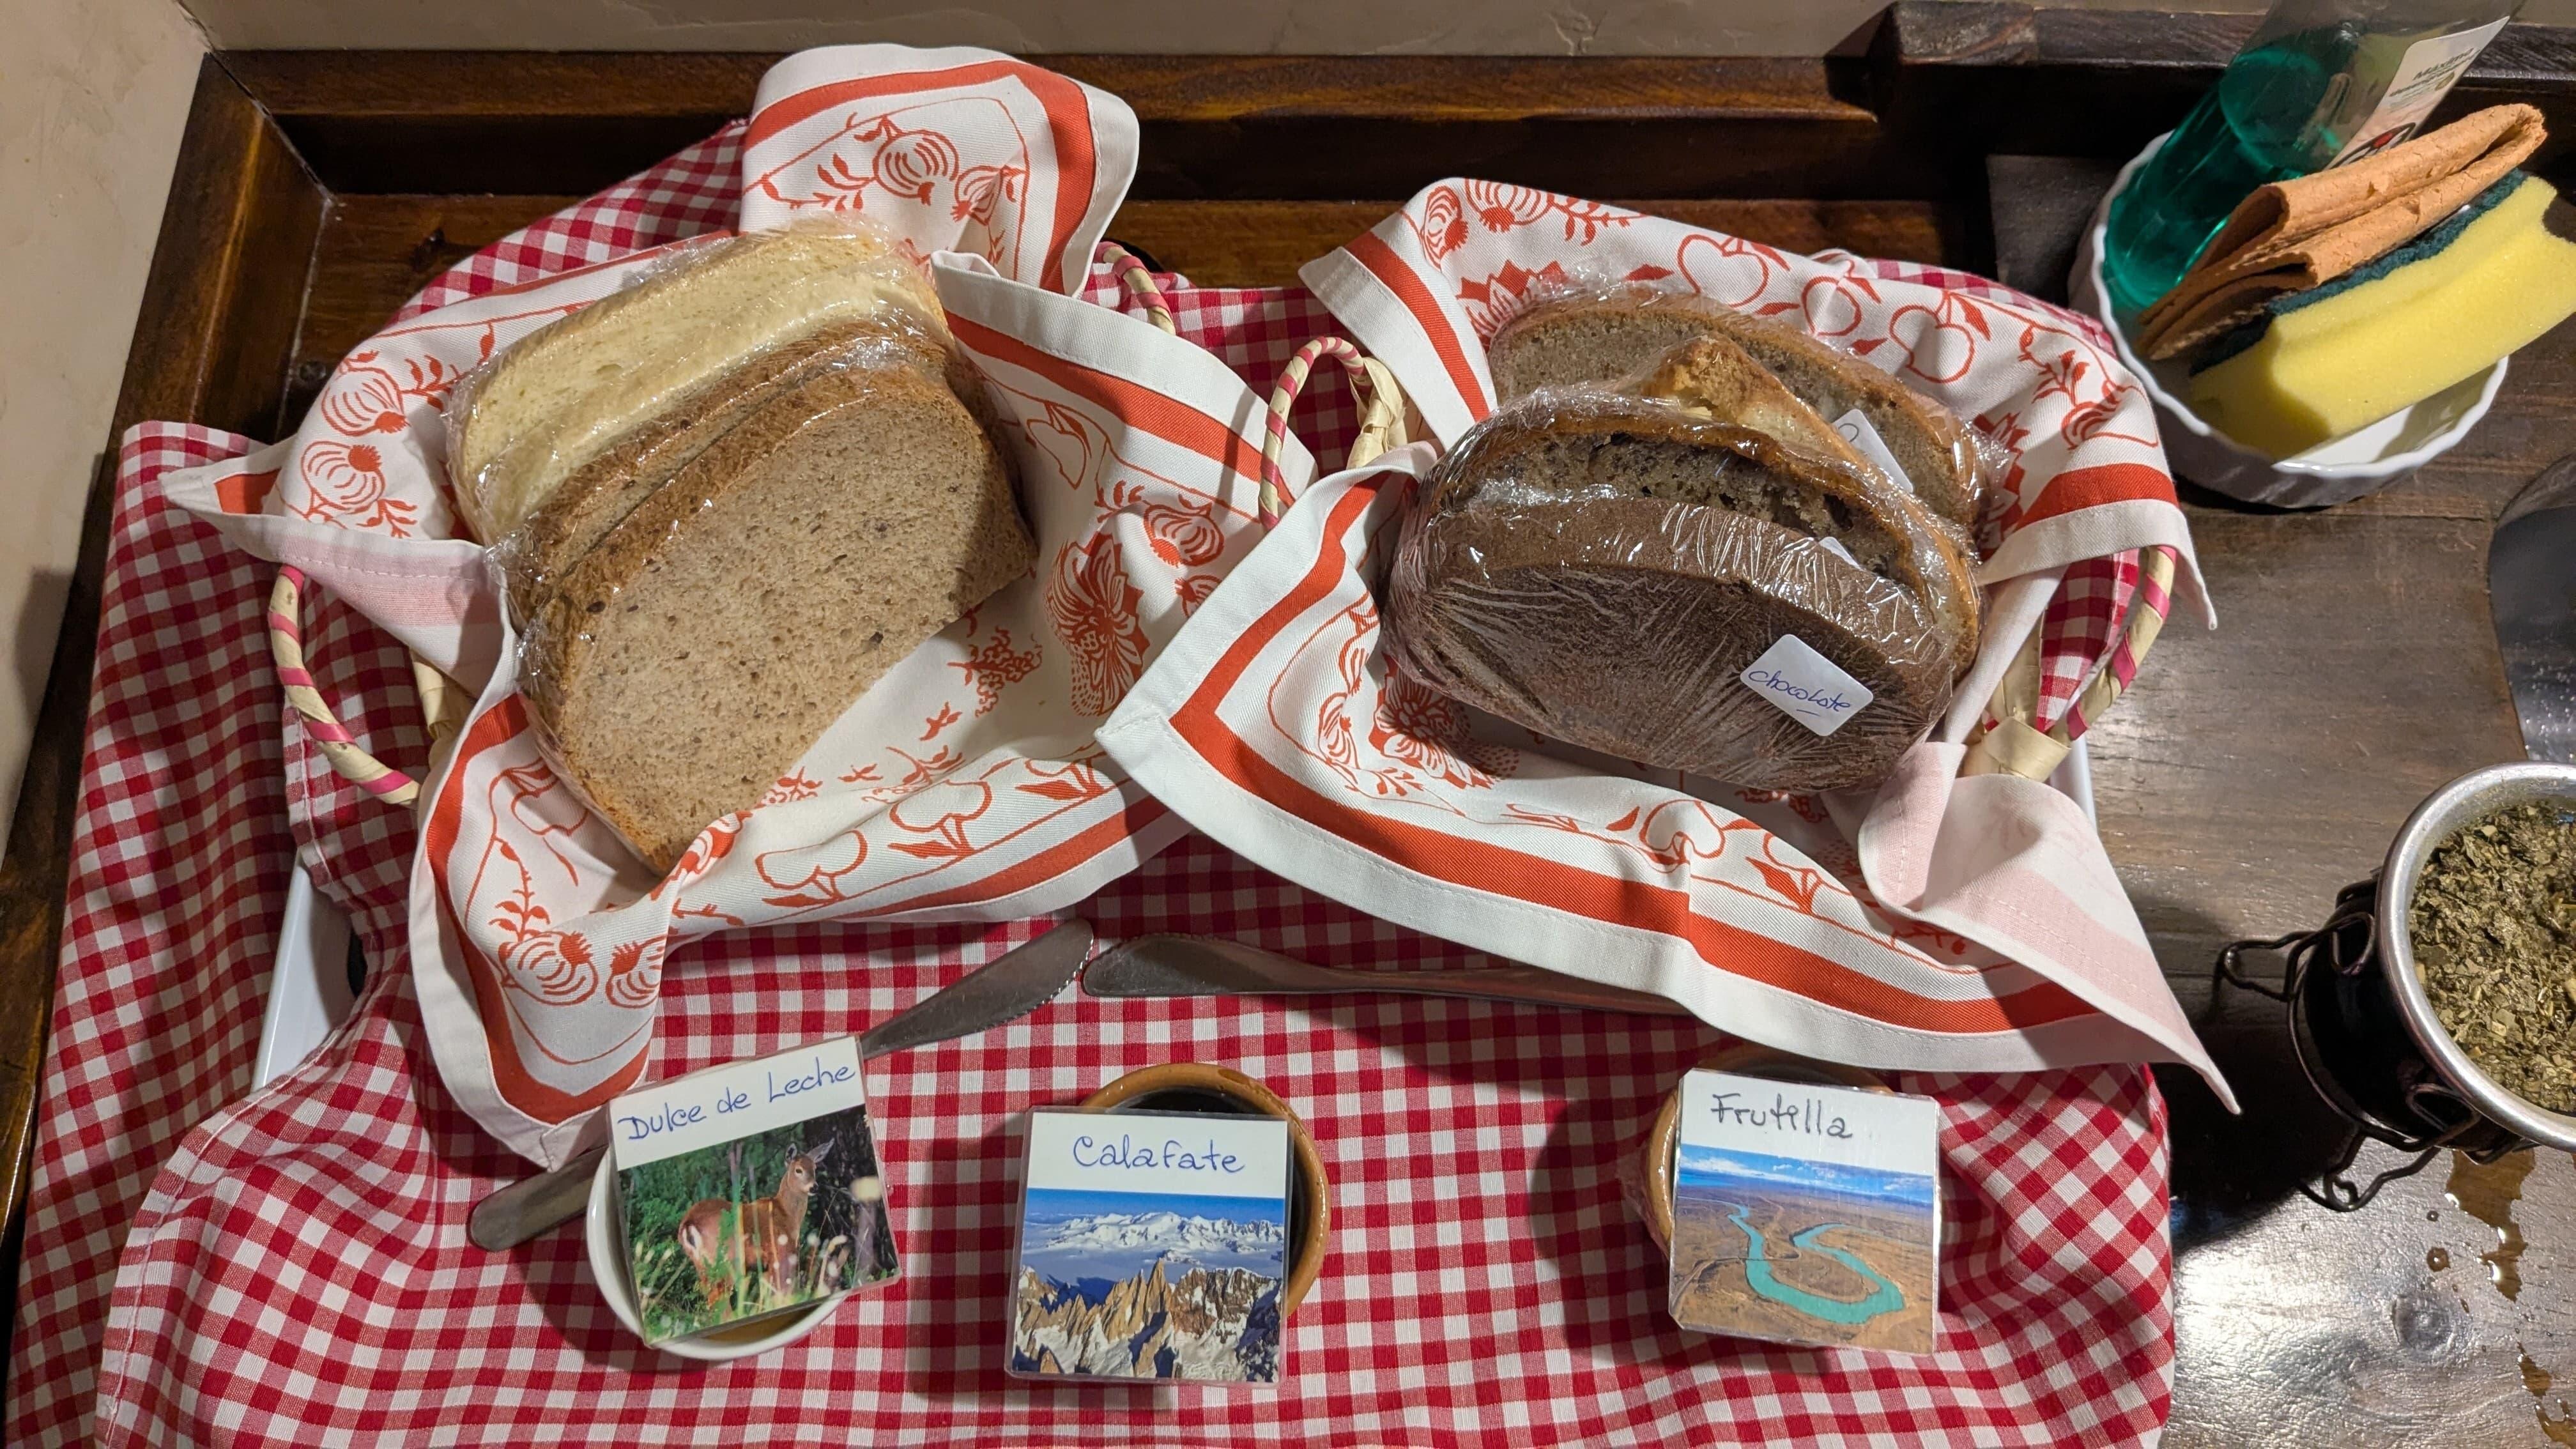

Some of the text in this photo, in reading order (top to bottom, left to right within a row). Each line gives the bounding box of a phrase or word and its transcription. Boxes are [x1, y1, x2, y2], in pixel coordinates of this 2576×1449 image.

[618, 1057, 855, 1140] Dulce de Leche
[1710, 1093, 1853, 1138] Frutilla
[1073, 1134, 1245, 1173] Calafate
